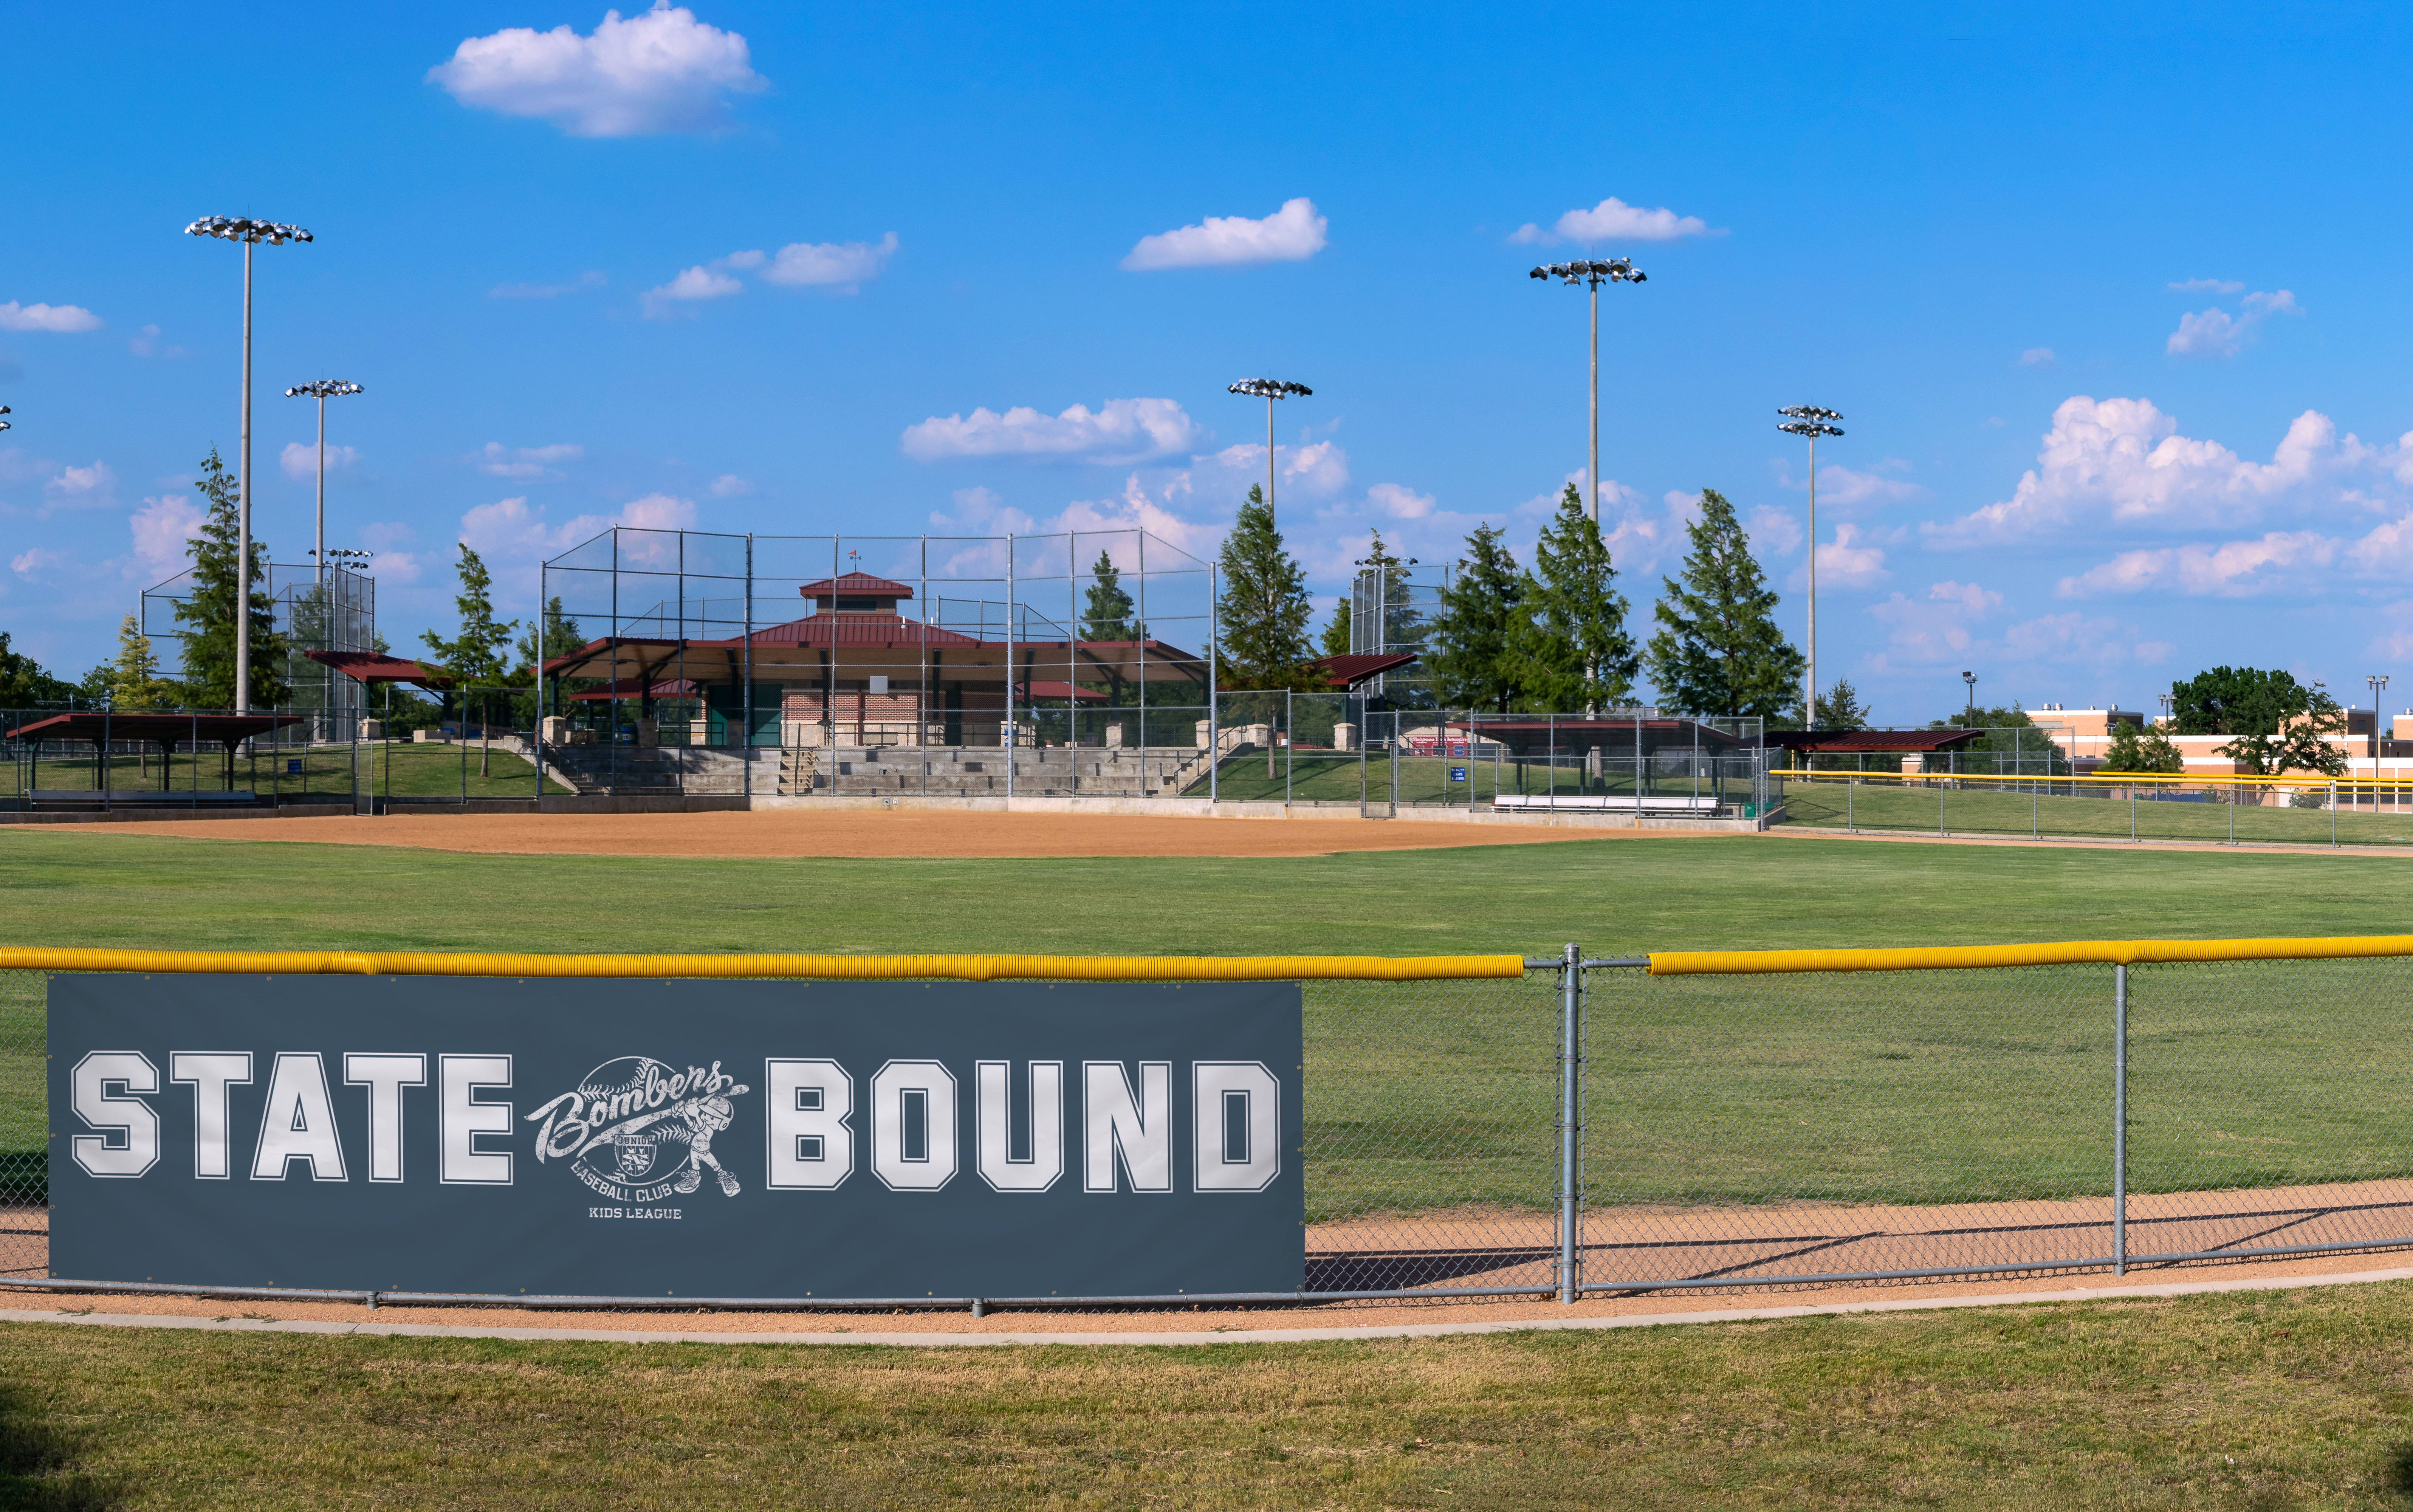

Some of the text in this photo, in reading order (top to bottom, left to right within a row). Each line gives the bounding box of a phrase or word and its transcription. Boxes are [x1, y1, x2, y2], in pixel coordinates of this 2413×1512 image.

[71, 1050, 1281, 1193] STATE BOUND
[524, 1060, 734, 1164] Bombers
[618, 1137, 653, 1145] JUNIOR
[570, 1160, 672, 1202] BASEBALL CLUB
[589, 1207, 681, 1219] KIDS LEAGUE
